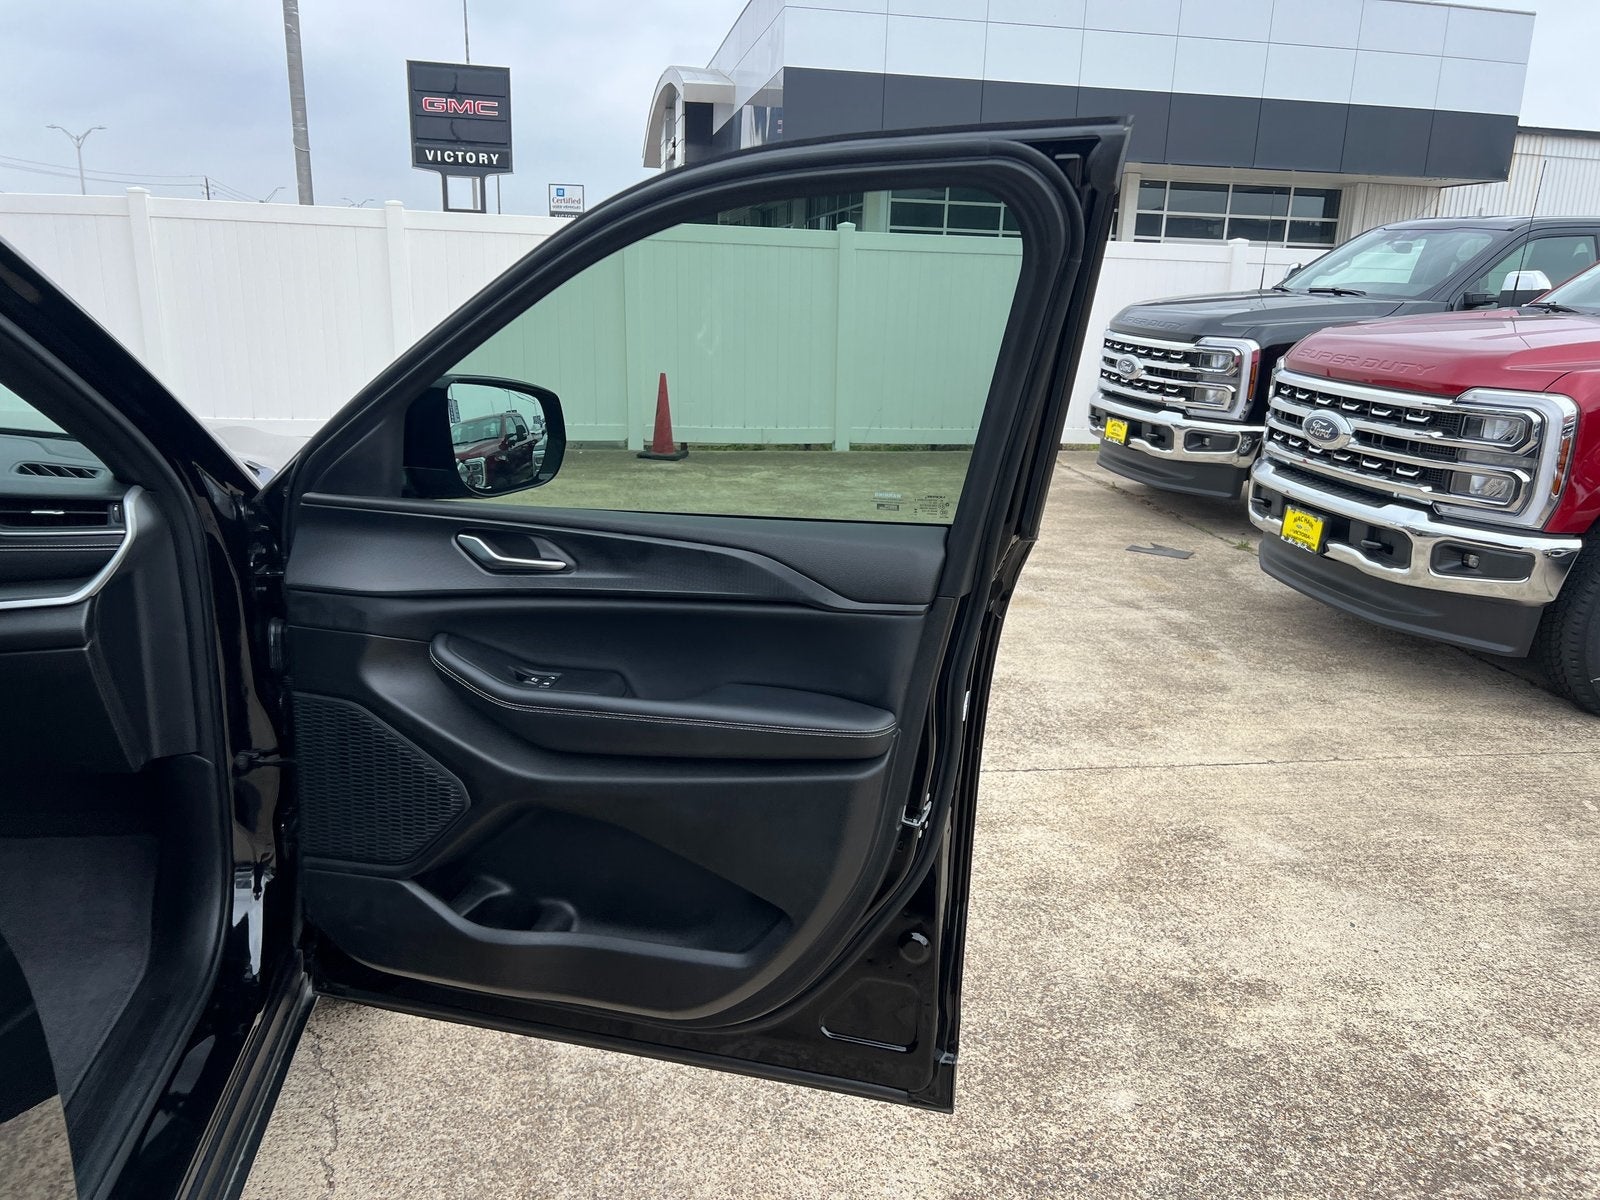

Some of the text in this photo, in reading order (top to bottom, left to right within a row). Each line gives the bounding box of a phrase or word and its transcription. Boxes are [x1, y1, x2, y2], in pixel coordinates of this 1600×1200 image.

[422, 96, 499, 116] GMC
[425, 149, 500, 165] VICTORY
[1298, 349, 1437, 376] SUPER DUTY
[1309, 419, 1333, 439] Ford
